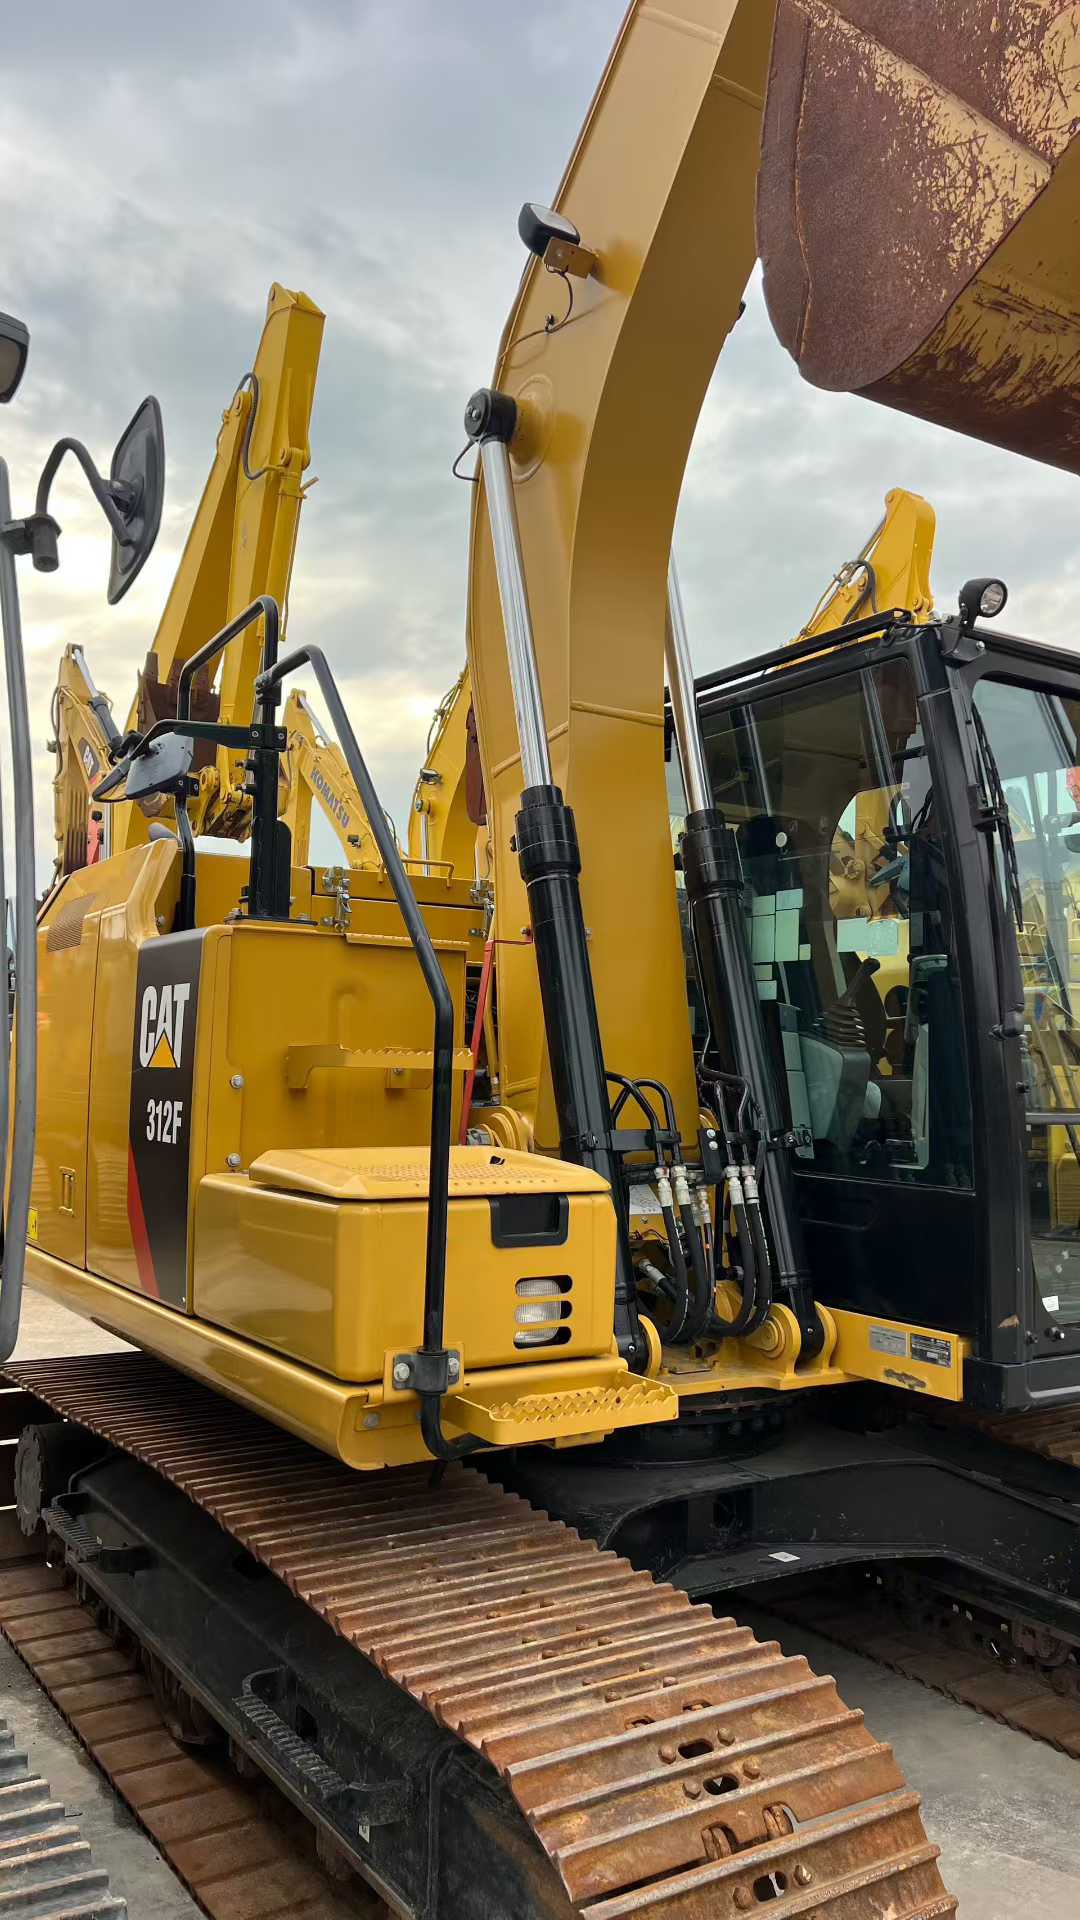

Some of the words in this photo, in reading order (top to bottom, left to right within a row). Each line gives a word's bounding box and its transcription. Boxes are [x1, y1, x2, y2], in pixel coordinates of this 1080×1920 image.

[311, 767, 350, 829] KOMATSU
[139, 982, 191, 1068] CAT
[146, 1098, 183, 1144] 312F
